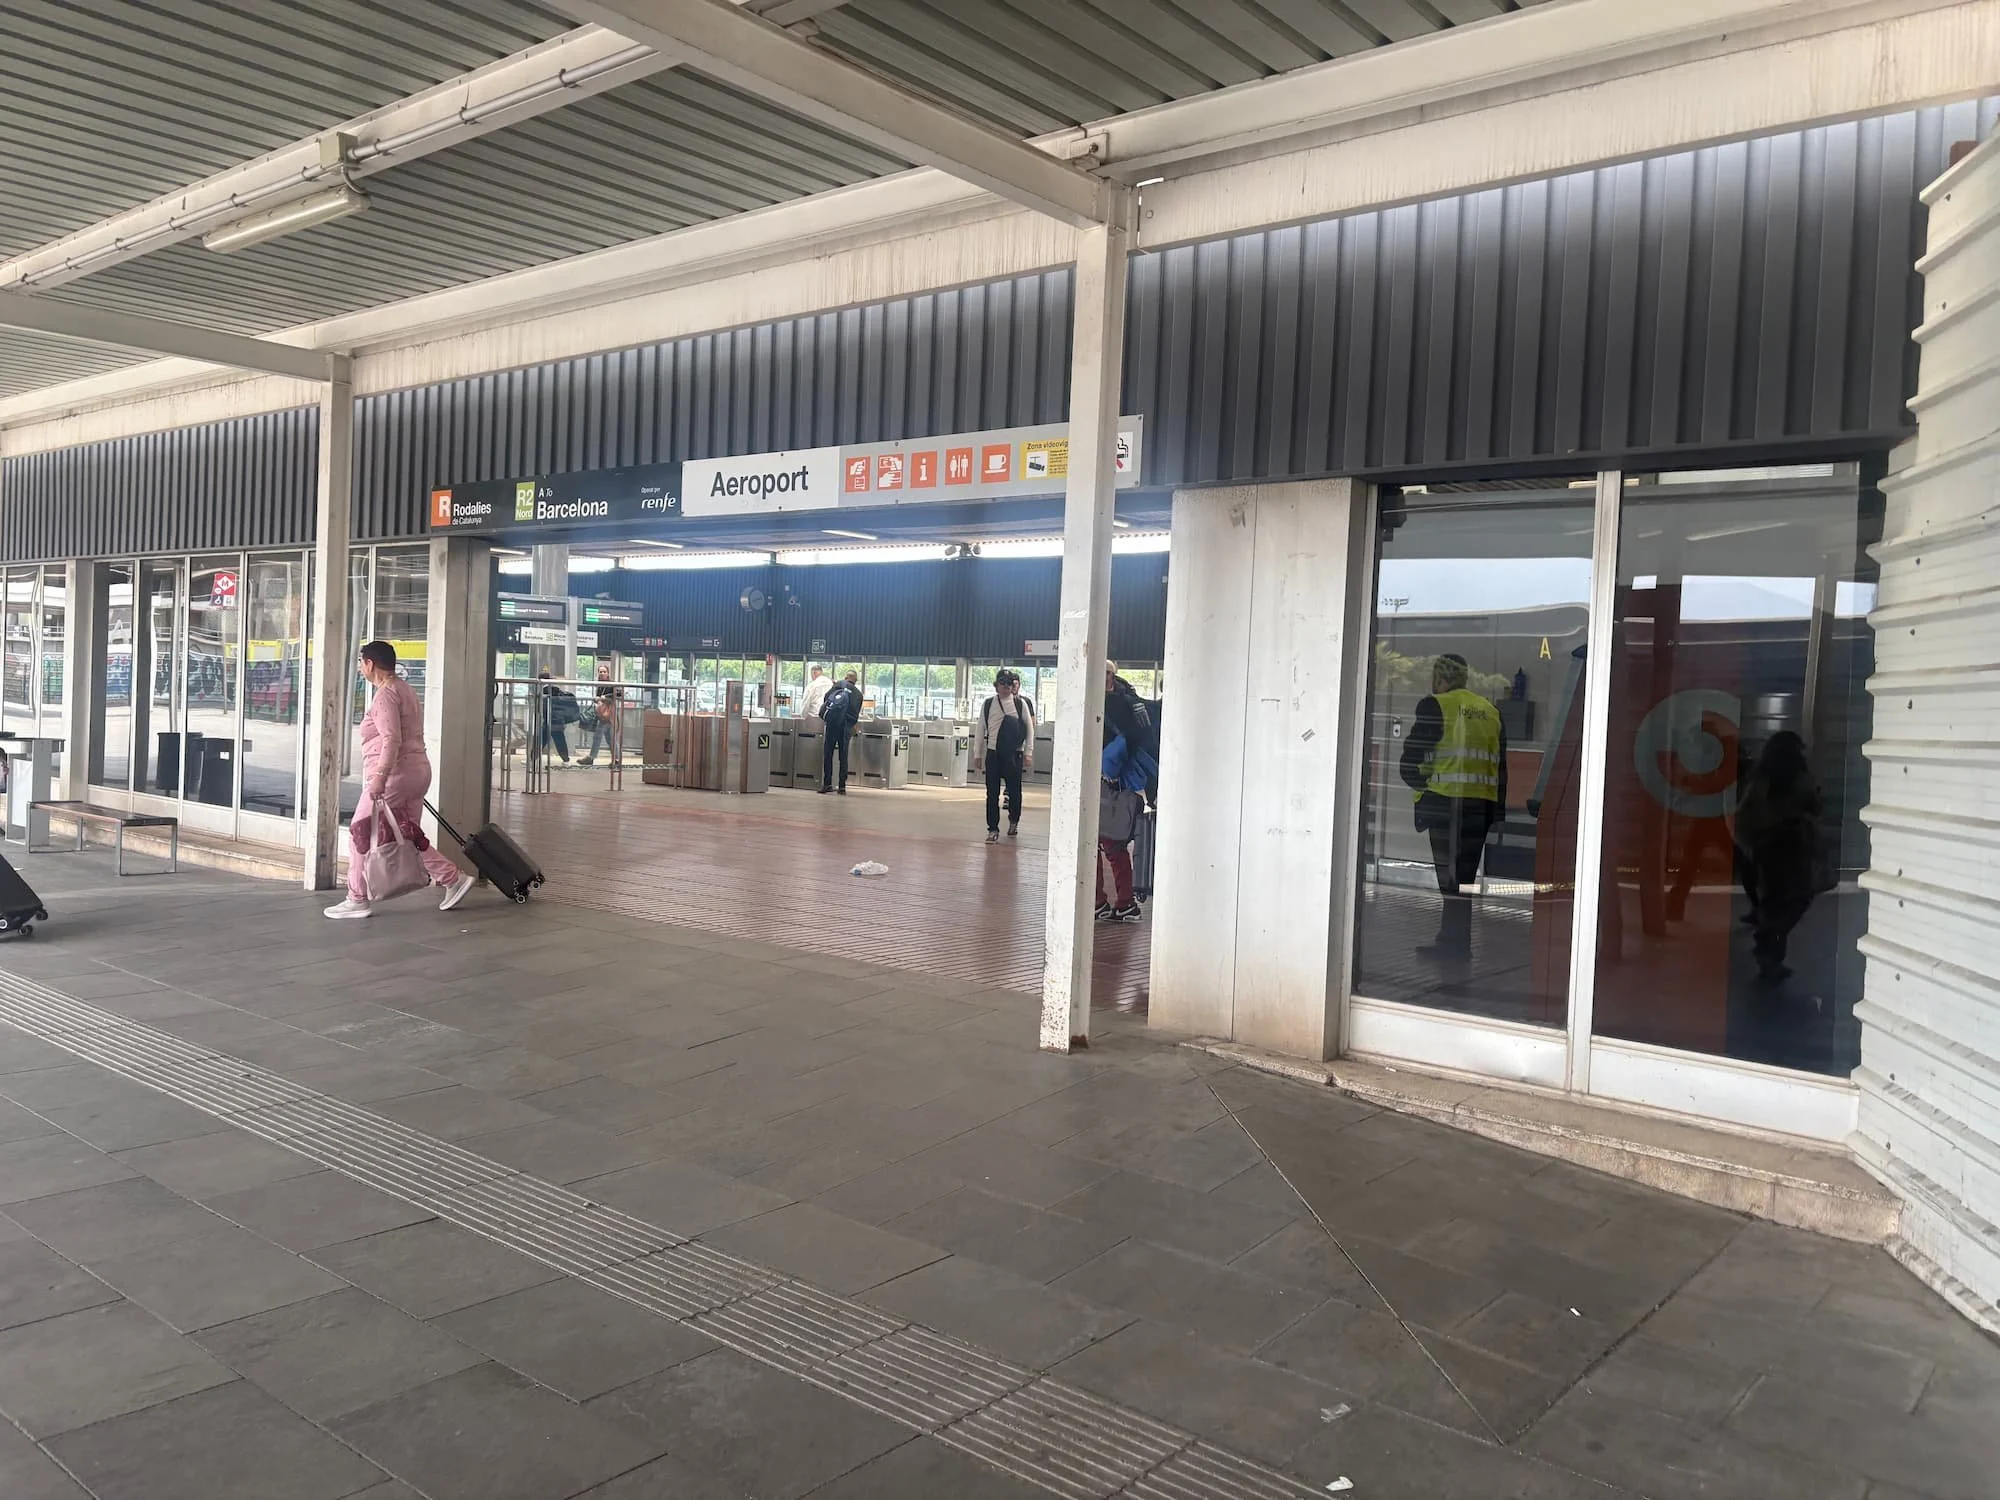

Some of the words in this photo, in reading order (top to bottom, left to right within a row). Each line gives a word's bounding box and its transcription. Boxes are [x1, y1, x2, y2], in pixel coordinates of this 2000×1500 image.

[710, 465, 809, 500] Aeroport
[516, 489, 534, 507] R2
[538, 488, 545, 498] A
[545, 487, 553, 497] To
[641, 491, 676, 513] renfe
[440, 496, 452, 517] R
[453, 501, 492, 517] Rodalies
[516, 509, 534, 518] Nord
[537, 498, 608, 520] Barcelona
[459, 516, 482, 526] Catalunya
[1540, 637, 1551, 660] A
